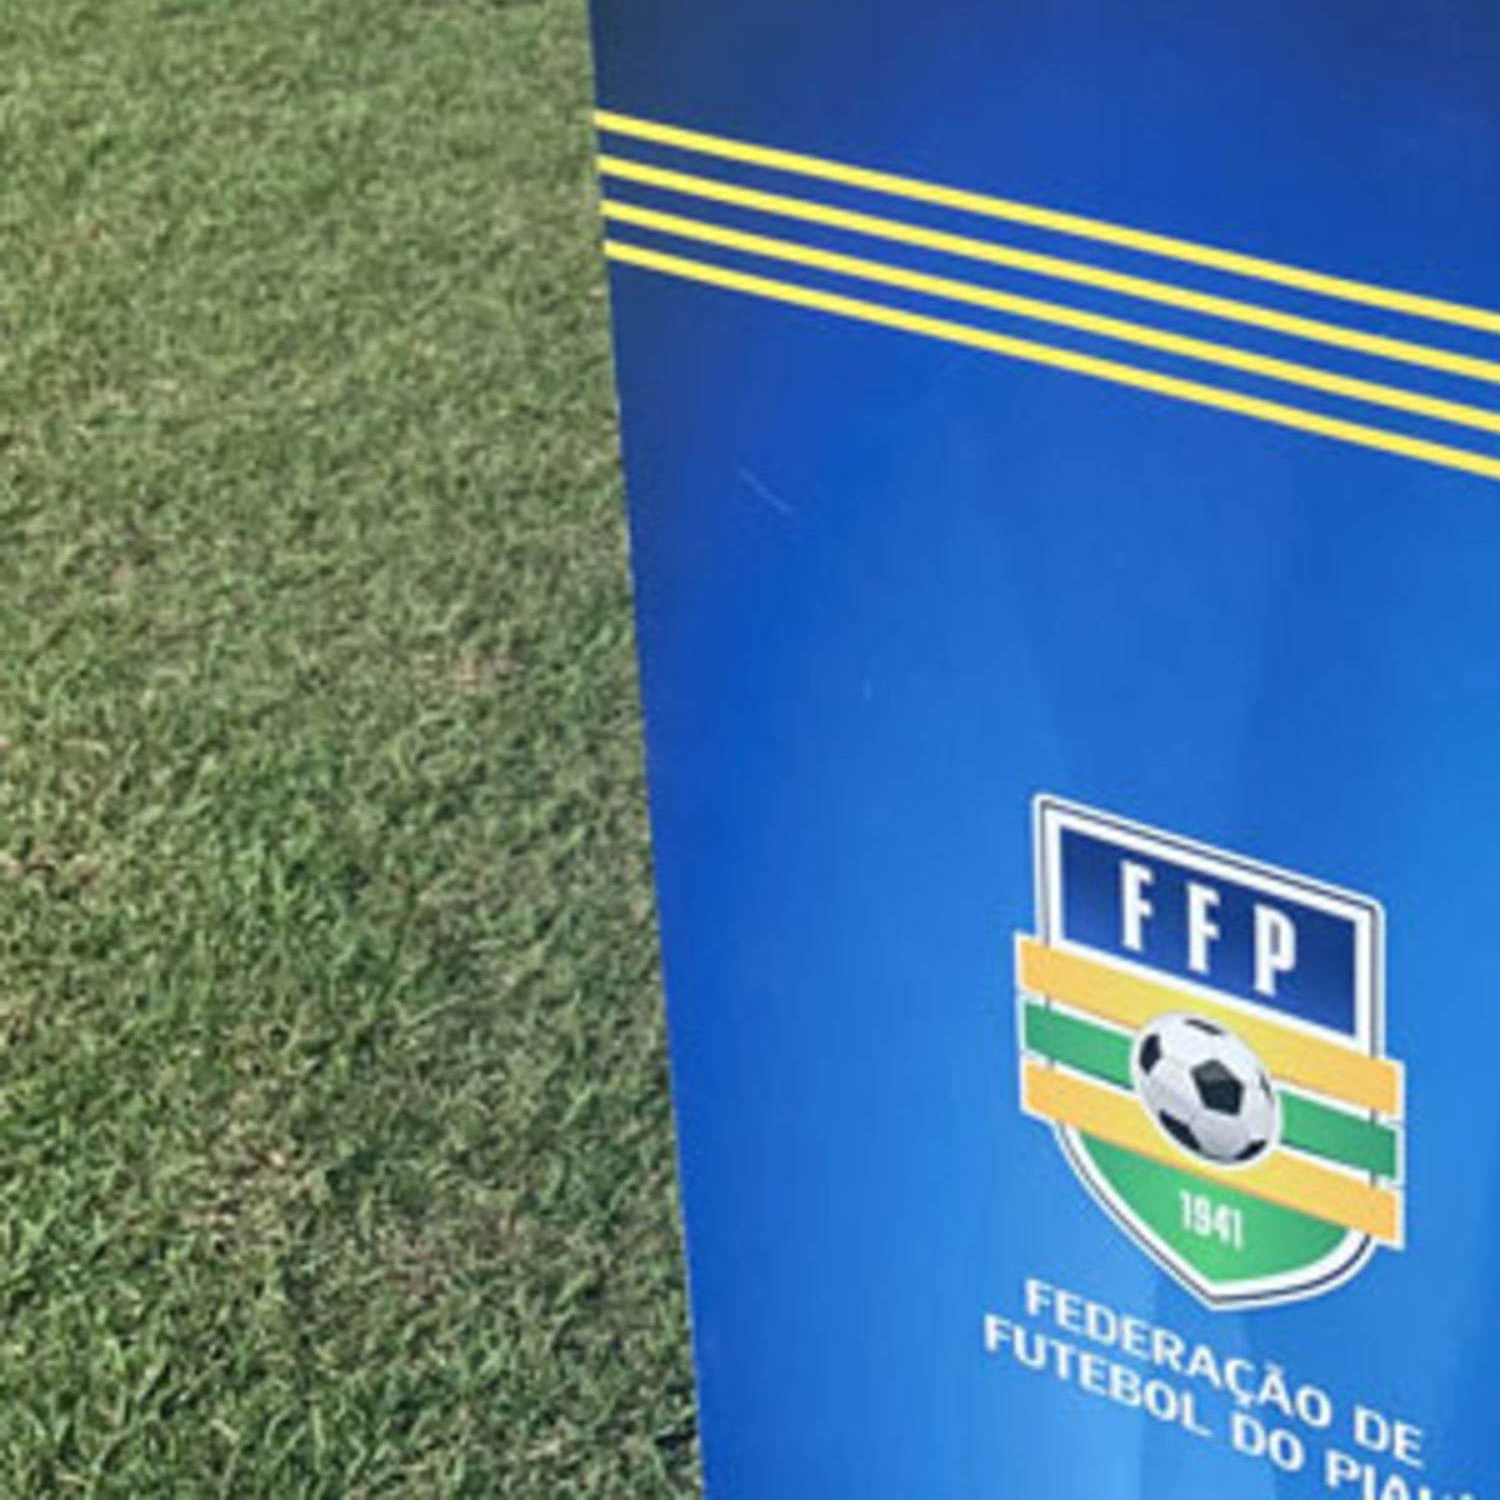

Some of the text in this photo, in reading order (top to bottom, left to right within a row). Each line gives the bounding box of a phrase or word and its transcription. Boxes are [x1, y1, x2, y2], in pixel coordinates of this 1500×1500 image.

[1122, 860, 1295, 996] FFP
[1180, 1190, 1243, 1249] 1941
[984, 1313, 1474, 1500] FUTEBOL DO PIA
[1025, 1277, 1423, 1468] FEDERAÇÃO DE
